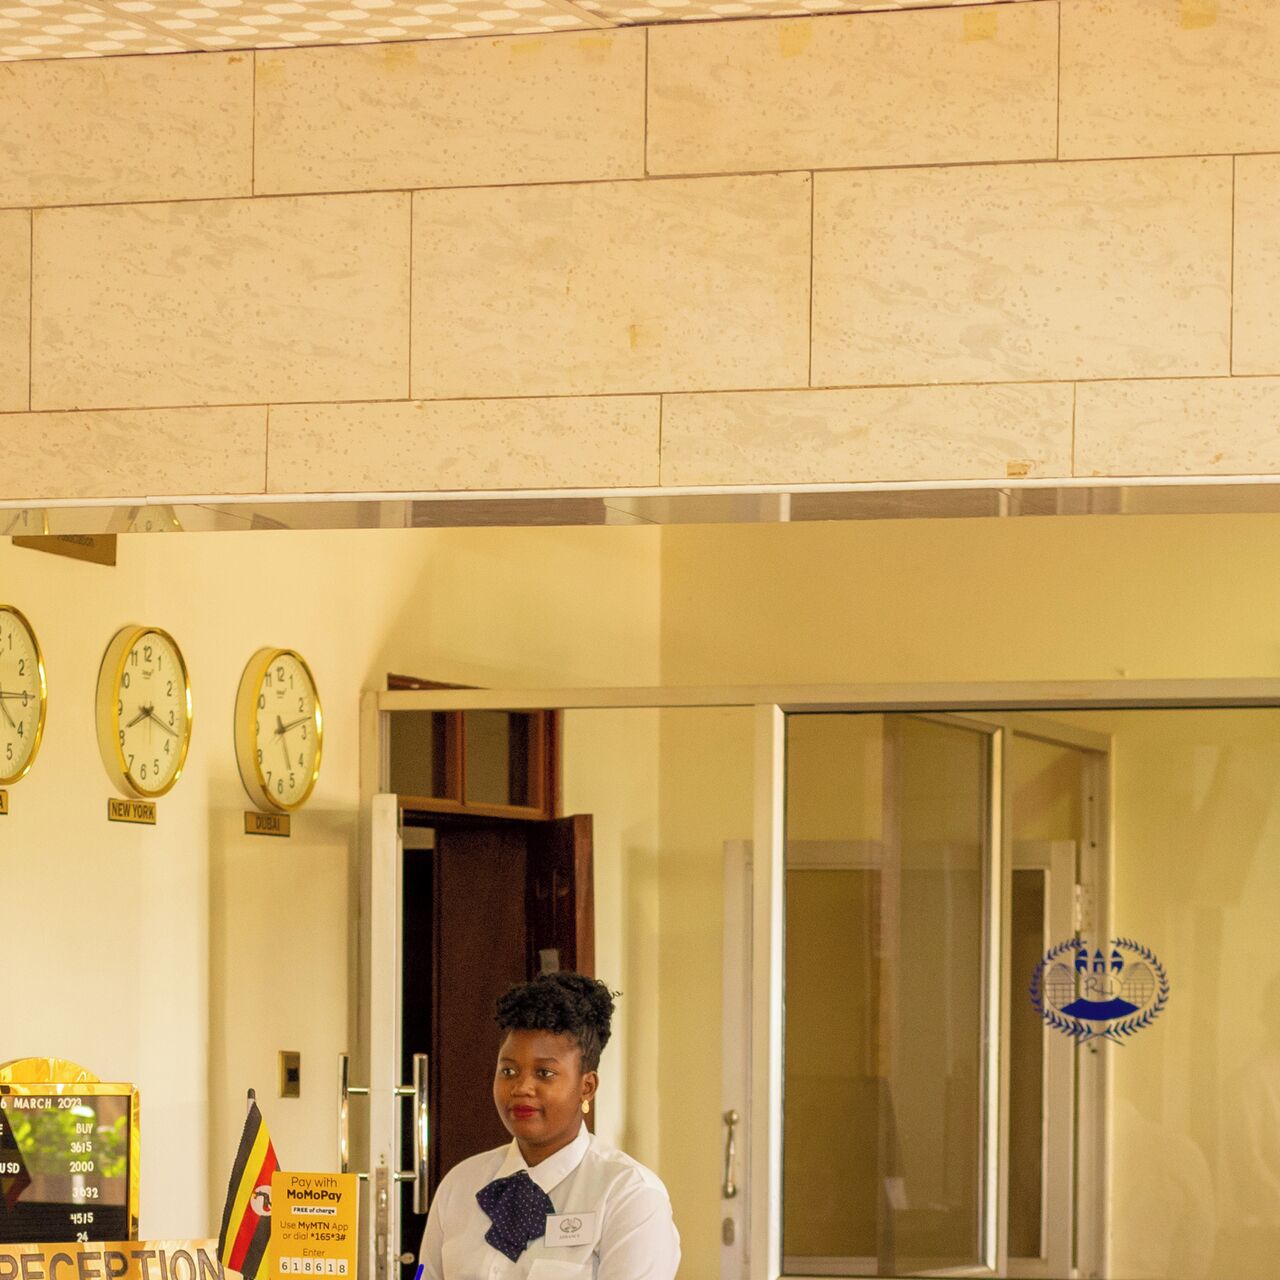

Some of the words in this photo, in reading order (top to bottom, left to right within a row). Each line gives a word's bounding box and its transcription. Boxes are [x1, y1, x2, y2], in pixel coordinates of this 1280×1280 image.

[8, 632, 12, 650] 1
[130, 650, 138, 667] 11
[143, 646, 152, 662] 12
[18, 658, 25, 676] 2
[157, 655, 162, 672] 1
[276, 667, 285, 682] 12
[290, 674, 294, 690] 1
[166, 680, 172, 697] 2
[298, 697, 304, 713] 2
[168, 710, 174, 726] 3
[17, 720, 24, 738] 4
[301, 725, 307, 740] 3
[6, 743, 13, 760] 5
[163, 738, 170, 755] 4
[128, 754, 134, 771] 7
[153, 759, 160, 775] 5
[298, 752, 304, 767] 4
[140, 763, 146, 780] 6
[277, 778, 284, 794] 6
[289, 772, 295, 789] 5
[111, 802, 131, 818] NEW
[132, 804, 155, 820] YORK
[255, 815, 280, 831] DUBAI
[13, 1098, 52, 1109] MARCH
[76, 1123, 93, 1134] BUY
[70, 1142, 92, 1153] 3615
[70, 1161, 94, 1173] 2000
[291, 1176, 312, 1189] Pay
[314, 1177, 338, 1188] with
[287, 1189, 342, 1203] MoMoPay
[70, 1212, 94, 1224] 4515
[280, 1221, 296, 1230] Use
[298, 1221, 330, 1231] MyMTN
[332, 1223, 349, 1232] App
[293, 1232, 308, 1241] dial
[302, 1248, 326, 1257] Enter
[282, 1261, 288, 1271] 6
[304, 1262, 312, 1272] 8
[316, 1262, 322, 1272] 6
[338, 1264, 346, 1274] 8
